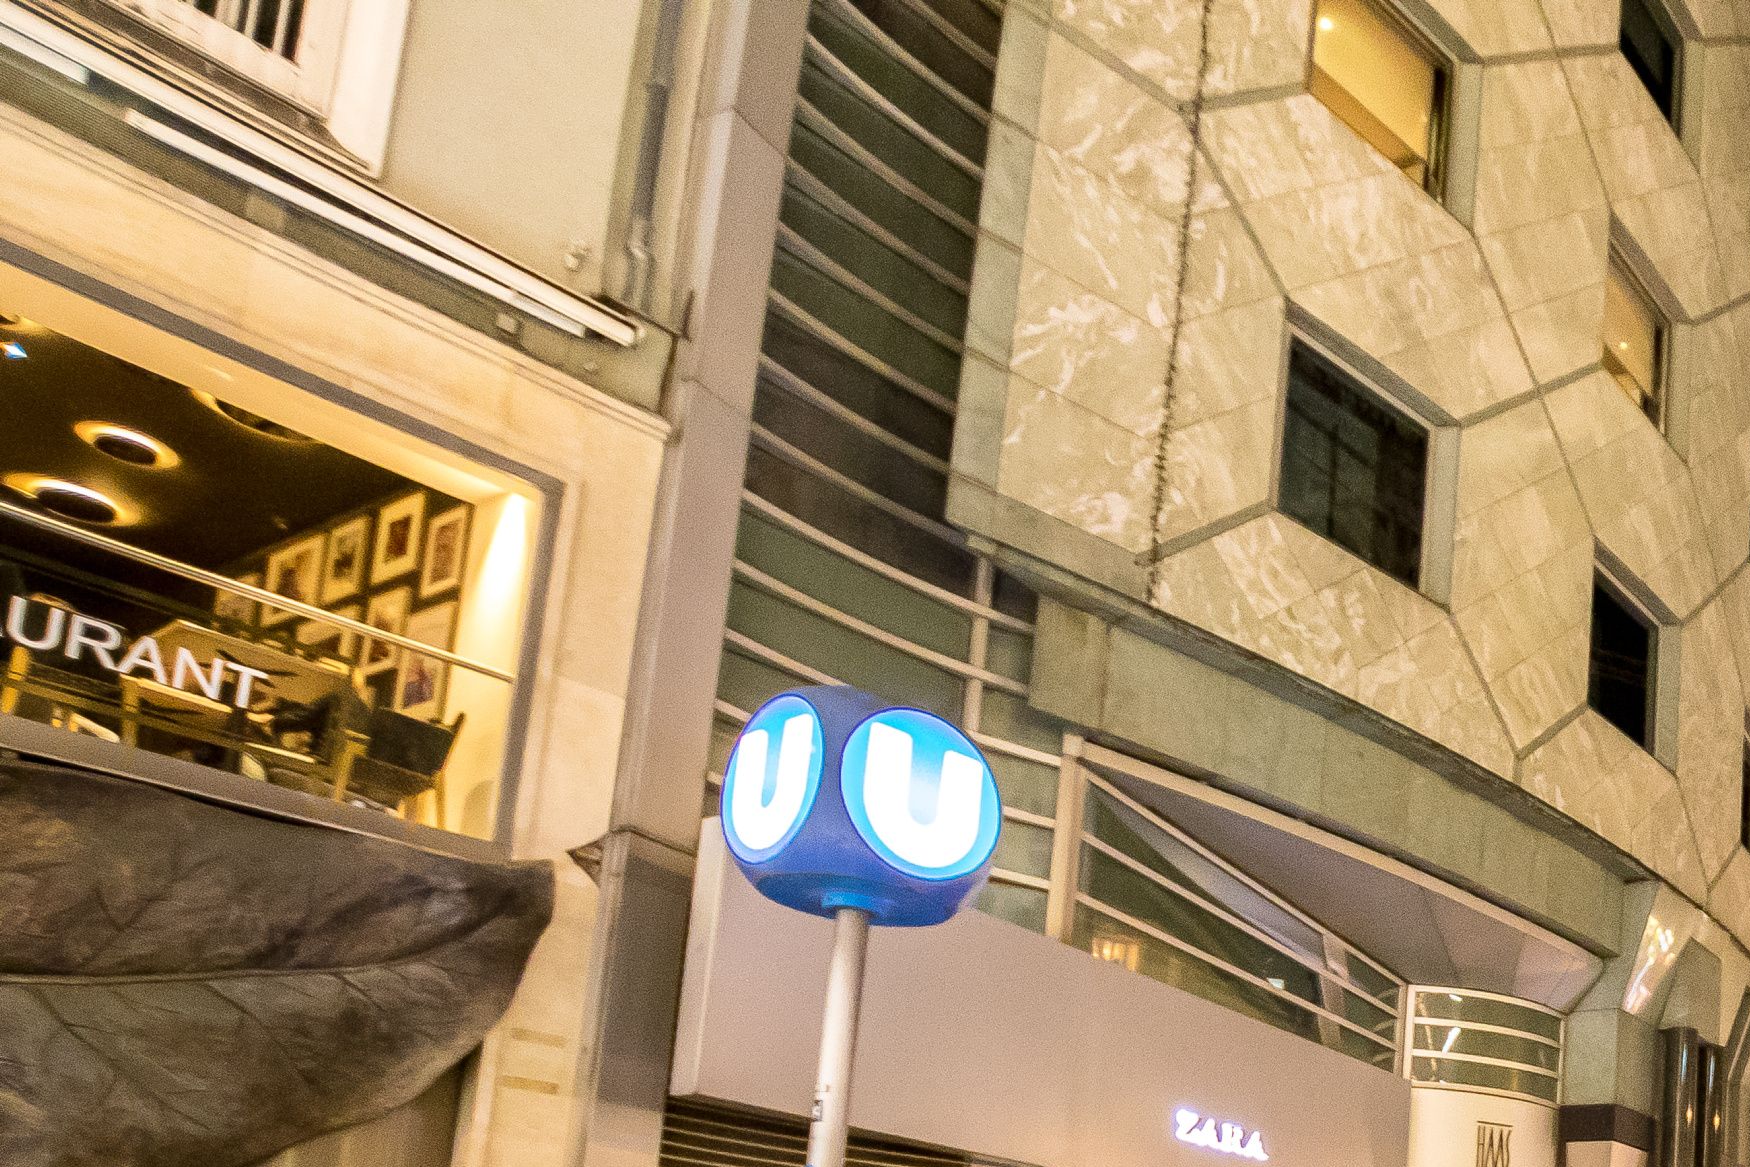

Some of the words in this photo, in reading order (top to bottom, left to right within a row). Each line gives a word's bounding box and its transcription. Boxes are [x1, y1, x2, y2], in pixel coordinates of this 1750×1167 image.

[0, 595, 269, 709] URANT
[732, 713, 814, 850] U
[863, 721, 984, 868] U
[1175, 1109, 1270, 1161] ZARA
